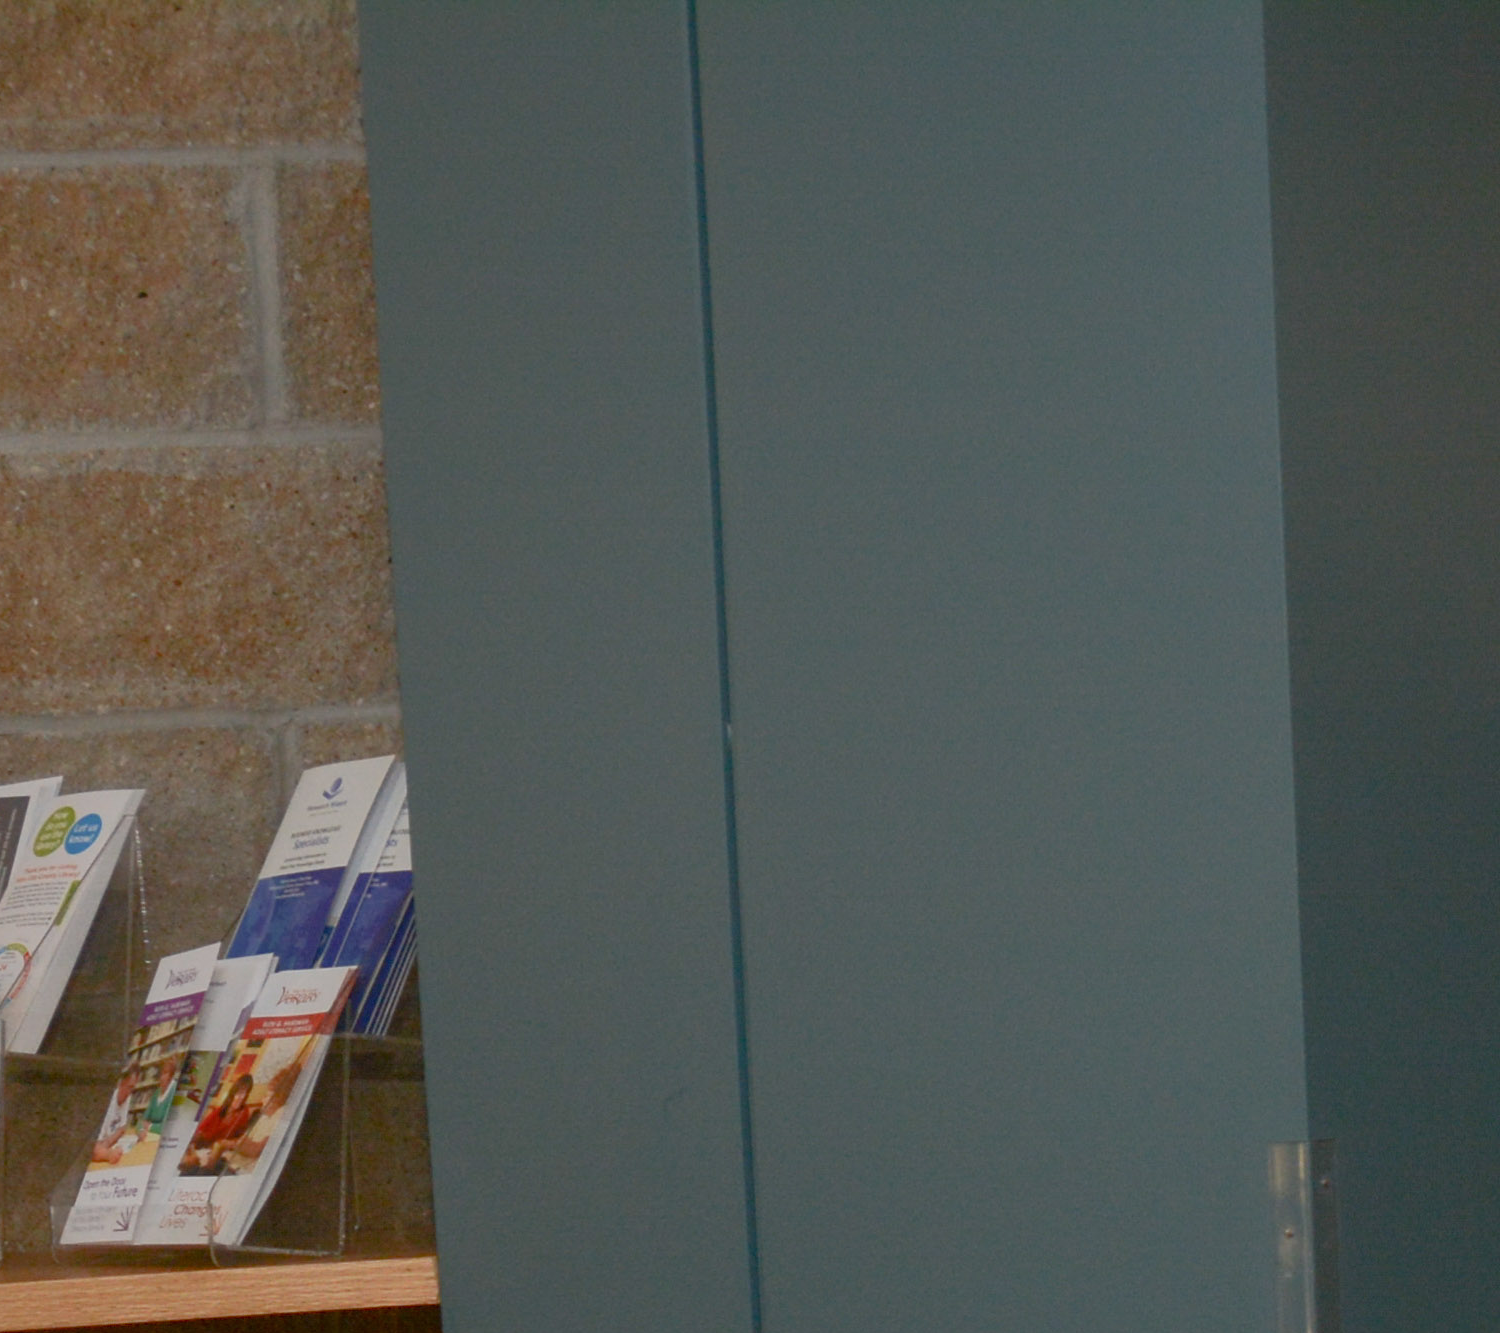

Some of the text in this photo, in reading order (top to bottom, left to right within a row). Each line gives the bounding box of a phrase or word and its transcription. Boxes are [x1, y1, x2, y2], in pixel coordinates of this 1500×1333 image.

[83, 1178, 103, 1190] Open
[114, 1186, 138, 1199] Future
[159, 1217, 187, 1230] Lives
